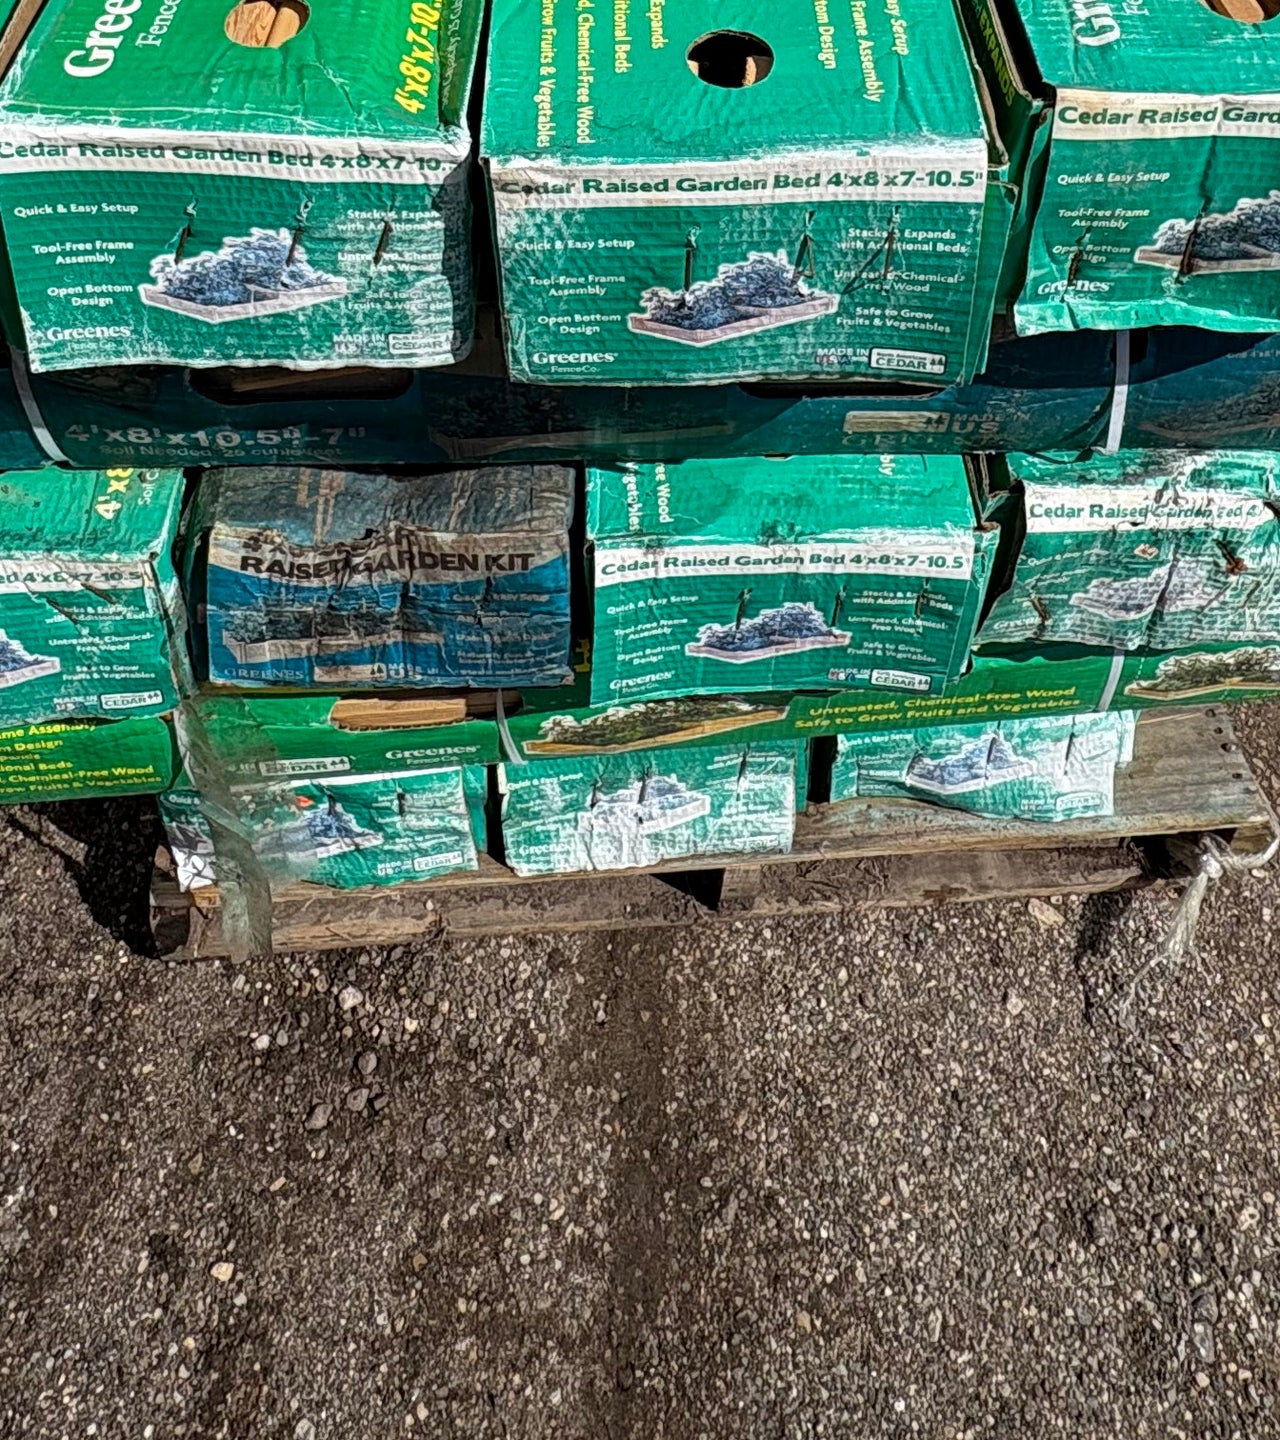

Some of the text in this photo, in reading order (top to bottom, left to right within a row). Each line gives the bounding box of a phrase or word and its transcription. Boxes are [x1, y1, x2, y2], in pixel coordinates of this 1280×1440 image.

[850, 0, 868, 37] Frame
[539, 27, 558, 64] Fruits
[817, 25, 839, 70] Design
[576, 13, 596, 103] Chemical-Free
[979, 12, 1016, 107] EXPANDS
[539, 66, 557, 76] &
[857, 38, 885, 102] Assembly
[533, 78, 557, 148] Vegetables
[1058, 106, 1134, 125] Cedar
[1138, 107, 1218, 125] Raised
[576, 105, 596, 144] Wood
[78, 144, 166, 159] Raised
[172, 145, 263, 164] Garden
[269, 150, 315, 167] Bed
[498, 181, 576, 195] Cedar
[582, 178, 670, 194] Raised
[675, 176, 768, 193] Garden
[773, 173, 820, 190] Bed
[1058, 171, 1170, 185] Quick & Easy Setup
[14, 203, 139, 218] Quick & Easy Setup
[46, 325, 131, 341] Greenes
[532, 352, 615, 365] Greenes
[875, 358, 927, 370] CEDAR
[1030, 503, 1150, 519] Cedar Raised
[484, 552, 535, 572] KIT
[601, 560, 658, 575] Cedar
[664, 556, 730, 568] Raised
[734, 554, 804, 567] Garden
[809, 554, 845, 565] Bed
[1026, 686, 1076, 698] Wood
[794, 699, 1081, 729] Safe to Grow Fruits and Vegetables
[385, 745, 478, 760] Greenes
